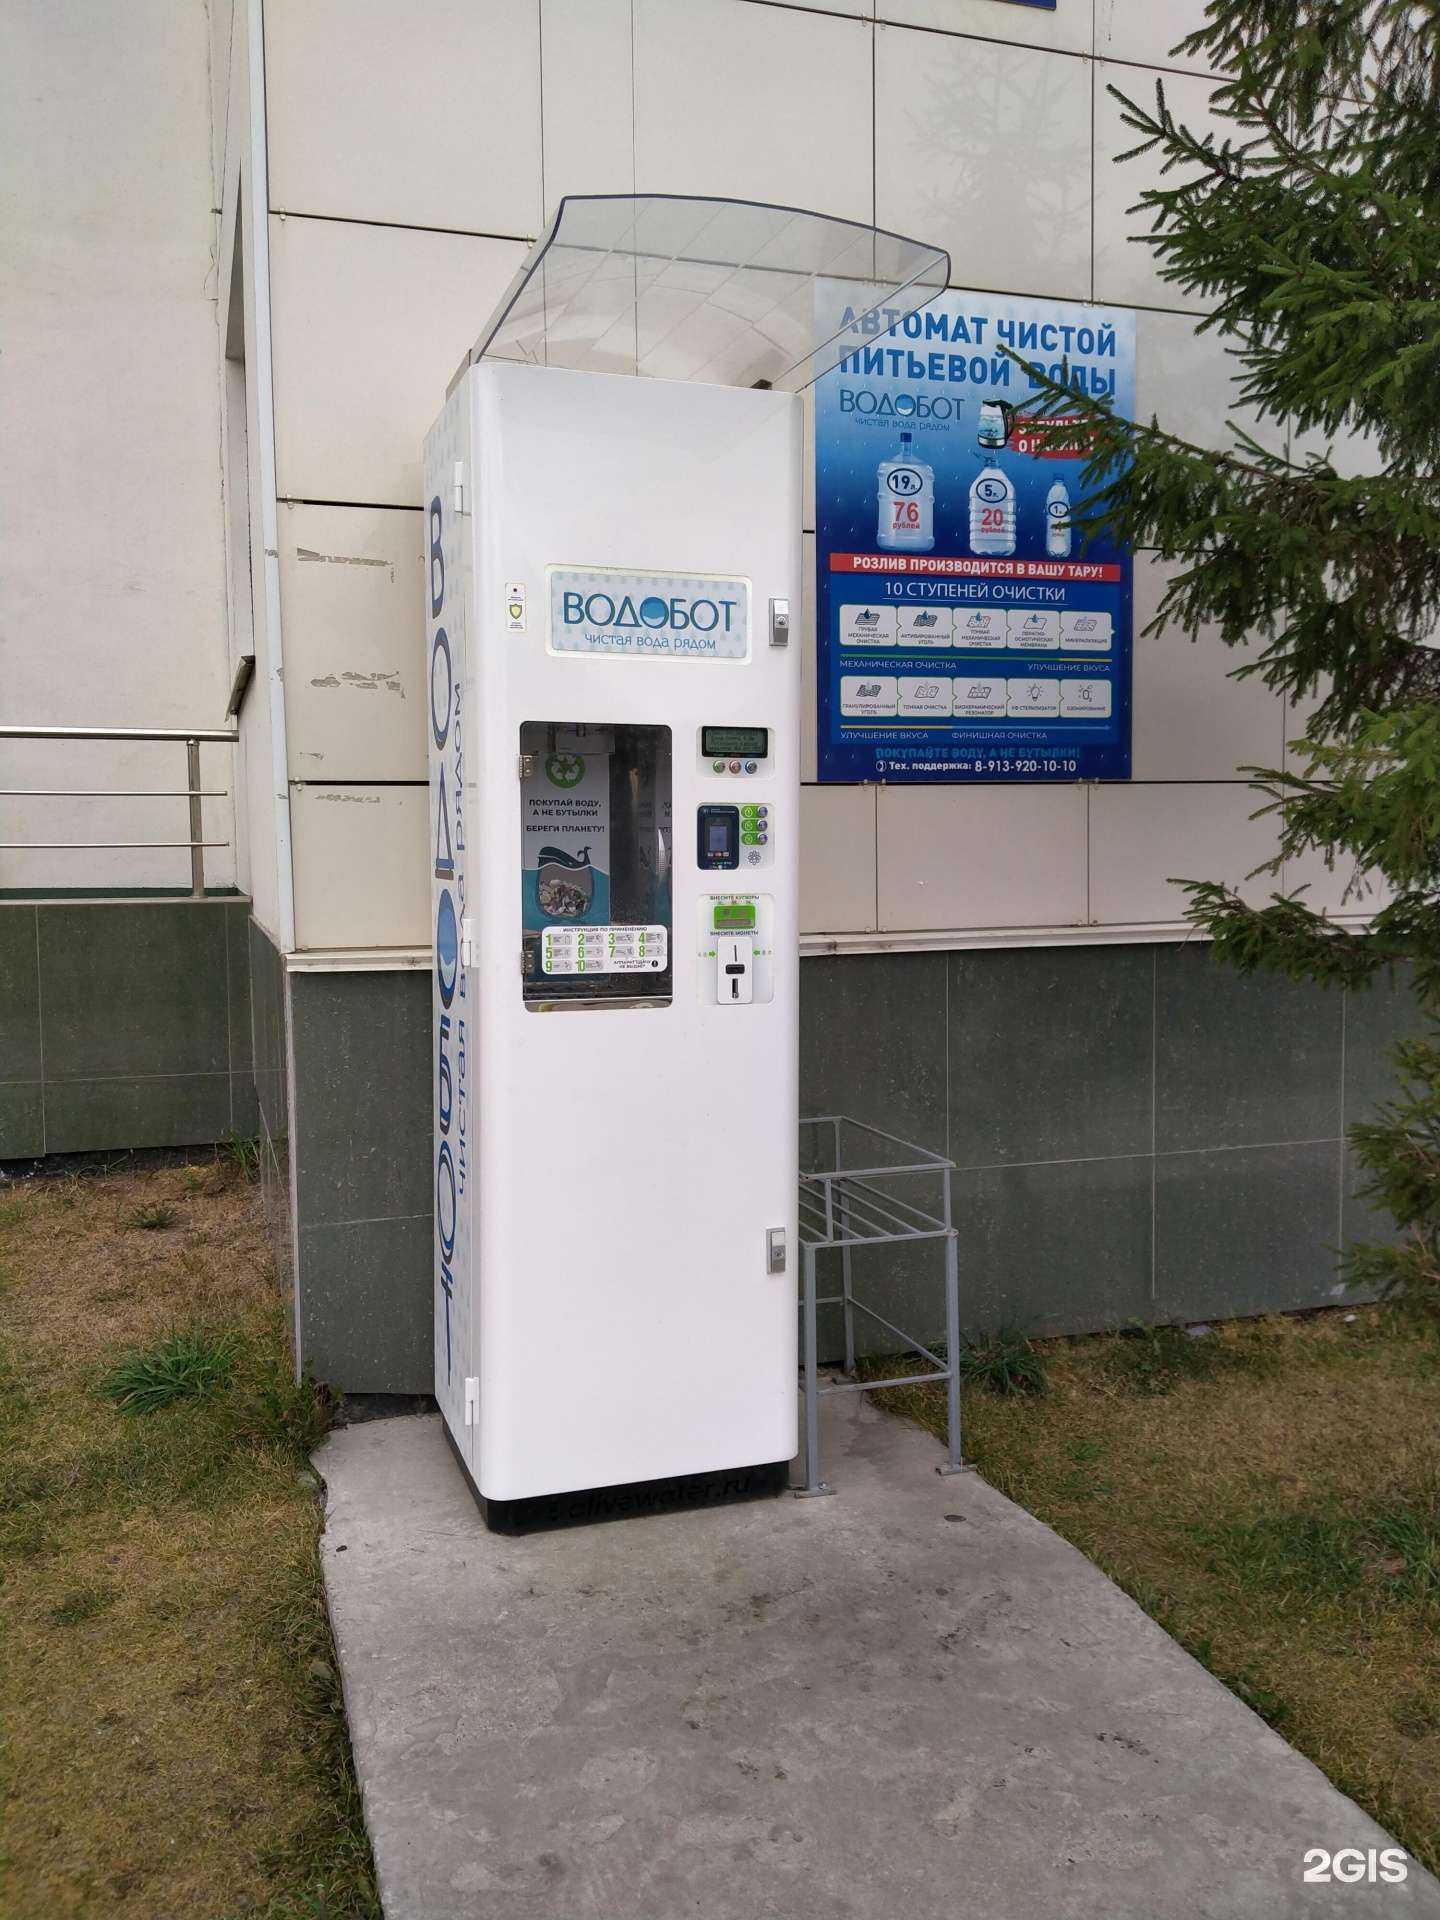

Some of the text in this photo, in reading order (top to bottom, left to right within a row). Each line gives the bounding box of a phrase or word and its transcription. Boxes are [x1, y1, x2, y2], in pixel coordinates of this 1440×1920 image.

[839, 305, 1116, 357] АВТОМАТ ЧИСТОЙ
[839, 345, 1010, 387] ПИТЬЕВОЙ
[839, 389, 965, 421] ВОДОБОТ
[855, 416, 950, 432] чистая вода рядом
[893, 501, 919, 522] 76
[982, 507, 1004, 526] 20
[892, 521, 920, 530] рублей
[853, 556, 1103, 578] РОЗЛИВ ПРОИЗВОДИТСЯ В ВАШУ ТАРУ!
[885, 582, 1066, 600] 10 СТУПЕНЕЙ ОЧИСТКИ
[563, 591, 738, 632] ВОДОБОТ
[584, 633, 717, 650] чистая вода рядом
[840, 660, 957, 669] МЕХАНИЧЕСКАЯ ОЧИСТКА
[1027, 663, 1111, 672] УЛУЧШЕНИЕ ВКУСА
[875, 747, 948, 759] ПОКУПАЙТЕ
[454, 683, 465, 850] рядом
[889, 760, 1077, 772] Тех. поддержка: 8-913-920-10-10
[529, 798, 602, 808] ПОКУПАЙ ВОДУ,
[555, 809, 598, 817] БУТЫЛКИ
[526, 825, 605, 833] БЕРЕГИ ПЛАНЕТУ!
[545, 934, 552, 946] 1
[578, 933, 585, 945] 2
[608, 933, 615, 945] 3
[639, 932, 645, 944] 4
[545, 947, 553, 959] 5
[578, 946, 585, 959] 6
[608, 945, 616, 957] 7
[639, 945, 645, 957] 8
[545, 960, 553, 972] 9
[576, 960, 585, 972] 10
[456, 1020, 466, 1194] чистая
